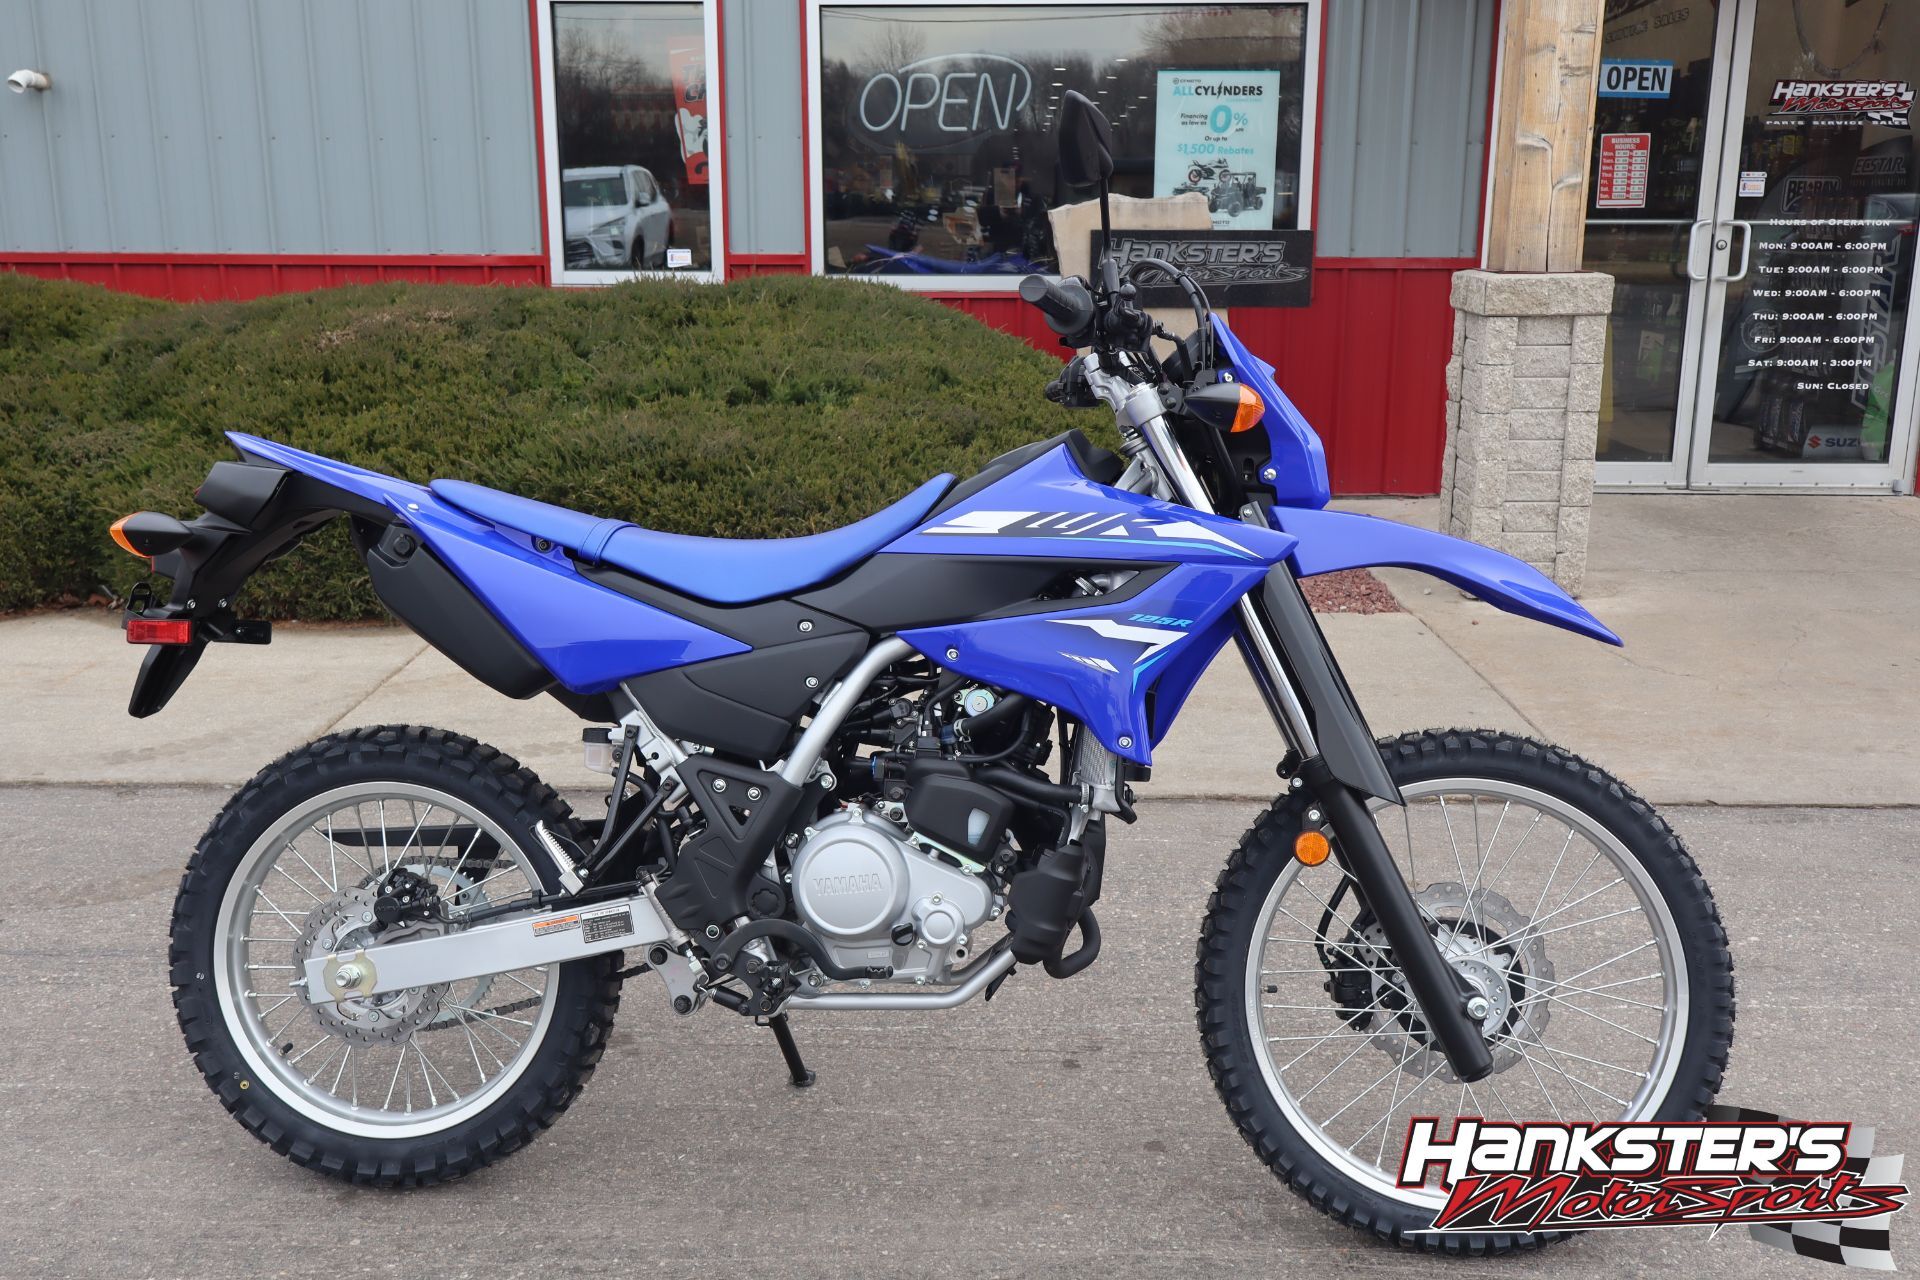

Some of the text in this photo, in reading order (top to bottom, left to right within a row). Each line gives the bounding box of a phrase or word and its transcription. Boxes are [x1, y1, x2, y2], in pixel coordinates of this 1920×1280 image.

[1653, 8, 1690, 29] SALES
[1606, 66, 1667, 92] OPEN
[860, 72, 1017, 132] OPEN
[1177, 143, 1254, 156] $1,500 Rebates
[1790, 242, 1833, 250] 9:00AM
[1845, 242, 1887, 250] 6:00PM
[1784, 289, 1827, 297] 9:00AM
[1839, 289, 1881, 297] 6:00PM
[1782, 312, 1824, 320] 9:00AM
[1836, 312, 1878, 320] 6:00PM
[1779, 336, 1822, 344] 9:00AM
[1833, 336, 1875, 344] 6:00PM
[1776, 359, 1819, 367] 9:00AM
[1830, 359, 1872, 367] 3:00PM
[1128, 613, 1194, 628] 125R
[812, 872, 884, 896] YAMAHA
